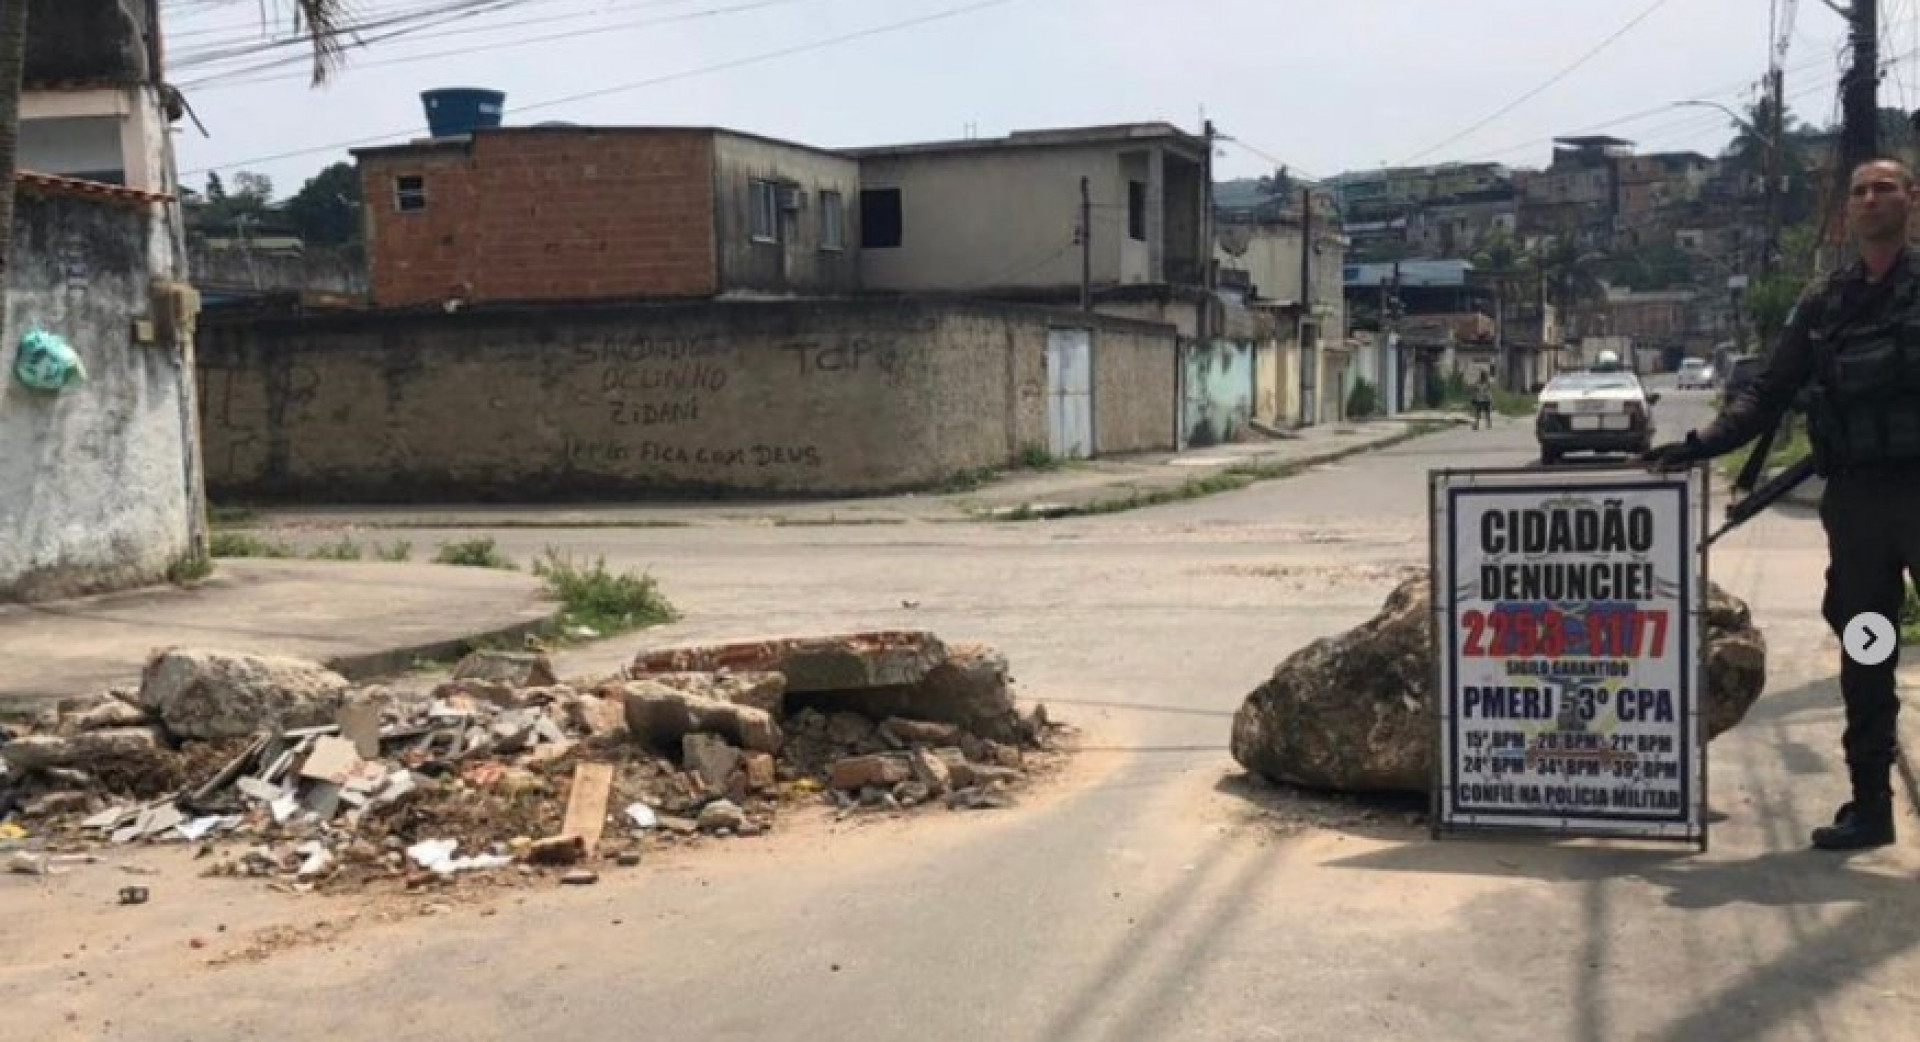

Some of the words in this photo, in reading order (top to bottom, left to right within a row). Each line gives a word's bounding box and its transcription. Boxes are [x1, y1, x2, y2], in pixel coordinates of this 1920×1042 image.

[778, 338, 874, 377] TCP
[752, 444, 822, 467] DEUS
[1480, 499, 1653, 554] CIDADÃO
[1480, 563, 1653, 601] DENUNCIE!
[1461, 609, 1669, 659] 2253-1177
[1552, 660, 1629, 677] GARANTIDO
[1463, 686, 1552, 719] PMERJ
[1616, 688, 1674, 722] CPA
[1492, 731, 1525, 749] BPM
[1564, 732, 1598, 750] BPM
[1638, 735, 1673, 753] BPM
[1492, 757, 1525, 774] BPM
[1566, 759, 1600, 776] BPM
[1643, 761, 1678, 779] BPM
[1460, 783, 1514, 803] CONFIE
[1518, 785, 1541, 804] NA
[1612, 788, 1680, 808] MILITAR
